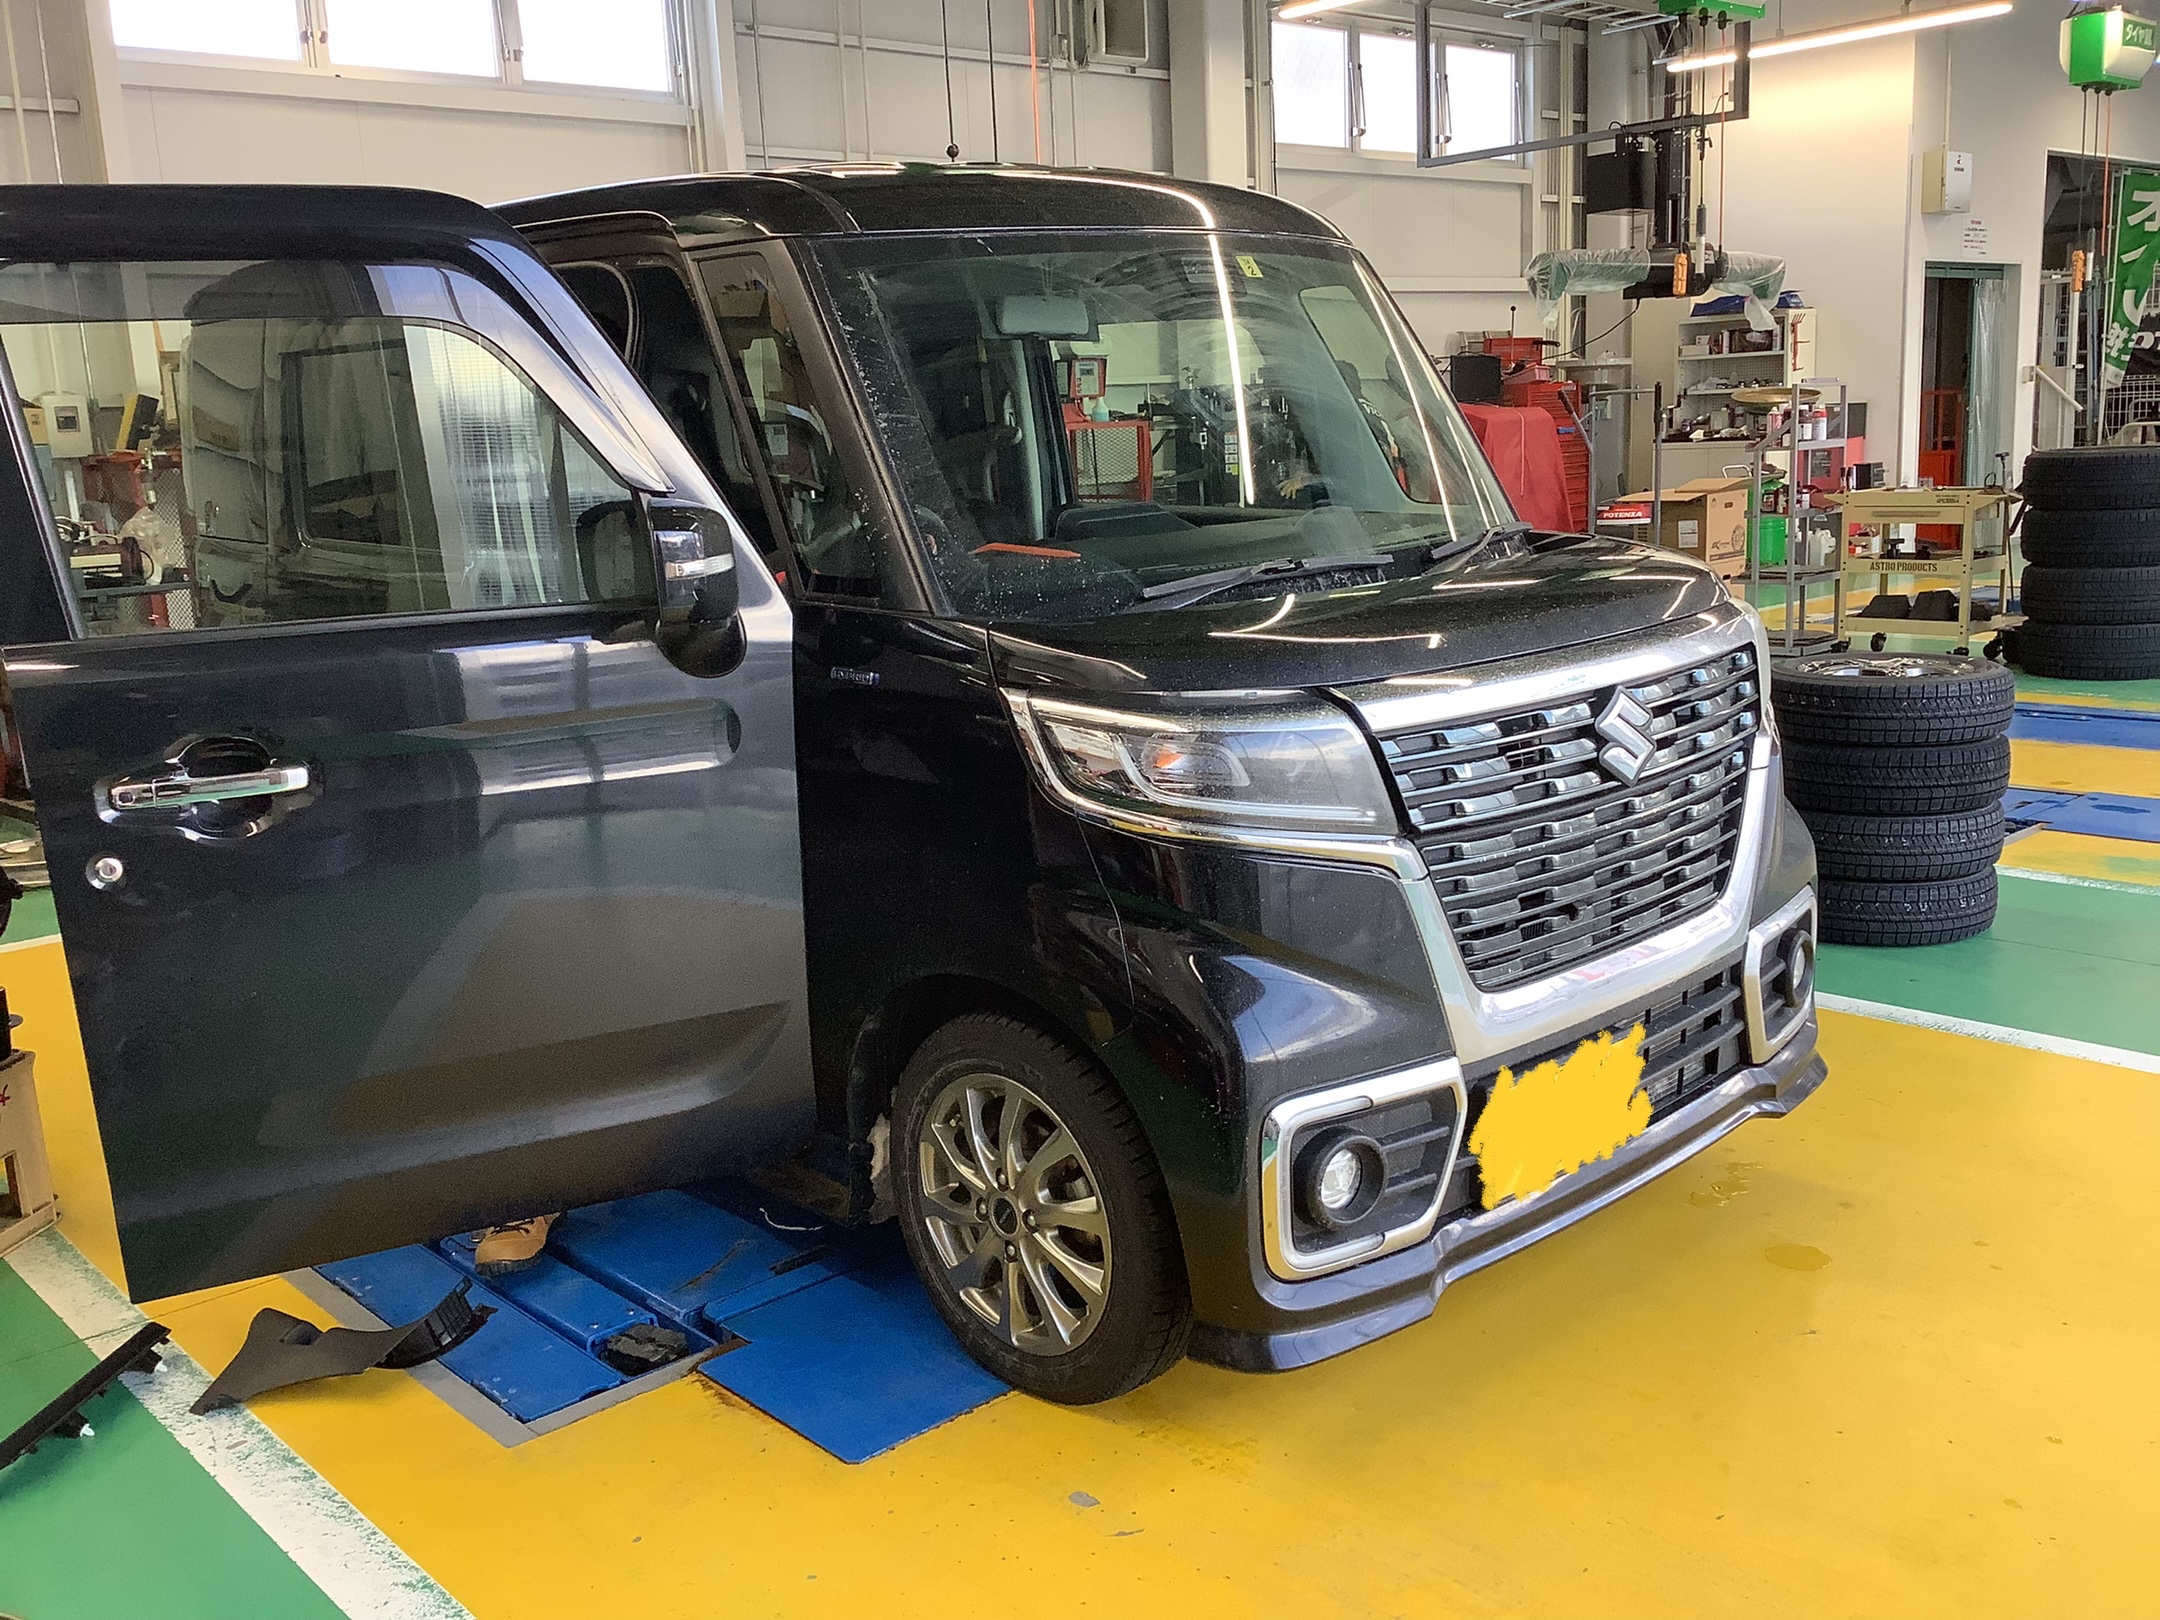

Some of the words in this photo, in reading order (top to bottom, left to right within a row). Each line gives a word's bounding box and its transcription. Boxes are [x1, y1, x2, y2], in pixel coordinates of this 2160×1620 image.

[1247, 265, 1257, 276] 2
[1869, 561, 1896, 571] ASTRO
[1896, 562, 1938, 572] PRODUCTS
